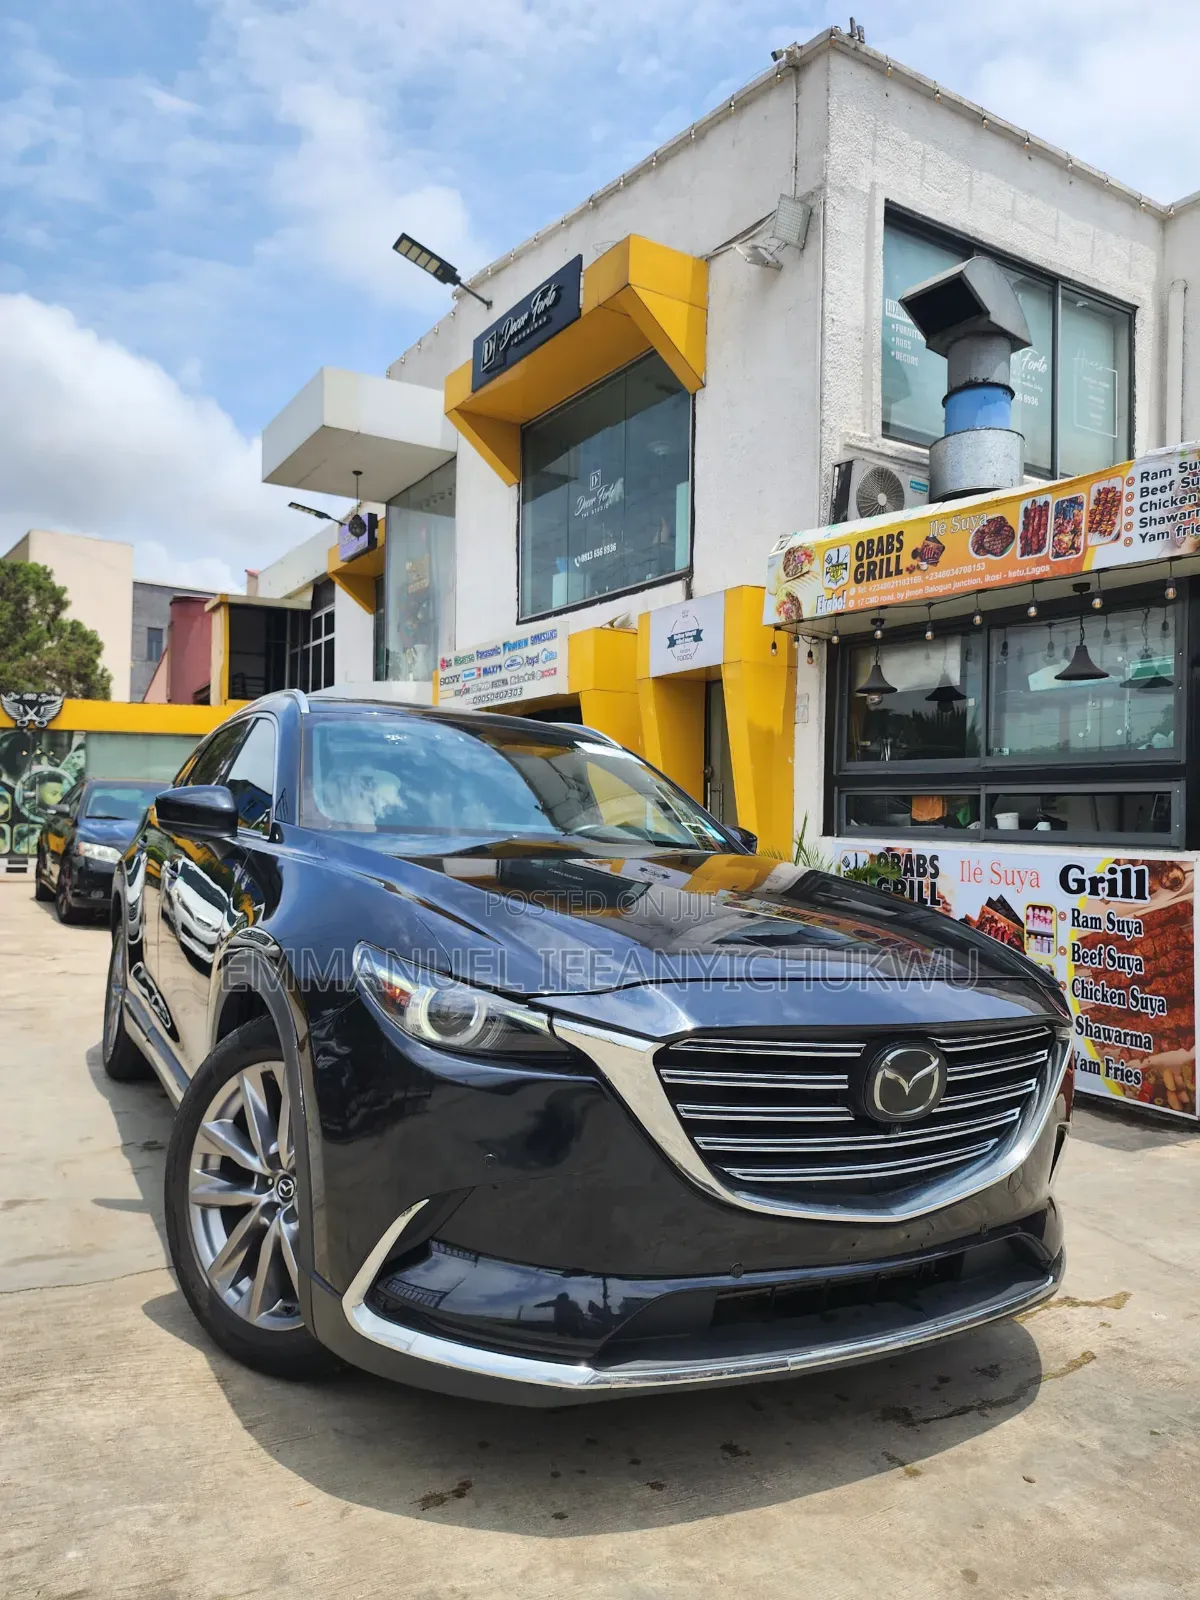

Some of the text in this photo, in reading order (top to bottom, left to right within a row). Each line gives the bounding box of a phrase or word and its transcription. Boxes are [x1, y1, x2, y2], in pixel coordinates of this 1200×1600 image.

[895, 336, 912, 350] RUGS
[895, 350, 919, 367] DECORS
[1139, 476, 1200, 498] Beef Su
[1140, 467, 1172, 483] Ram
[1139, 492, 1197, 513] Chicken
[949, 512, 988, 533] Suya
[1138, 530, 1170, 543] Yam
[581, 550, 593, 563] 0813
[593, 547, 603, 559] 656
[855, 530, 904, 562] OBABS
[853, 554, 903, 584] GRILL
[476, 645, 501, 660] Panasonic
[530, 628, 558, 646] SAMSUNG
[440, 674, 461, 686] SONY
[525, 652, 540, 668] Royal
[960, 858, 983, 883] Ilé
[990, 861, 1041, 894] Suya
[1058, 863, 1149, 901] Grill
[1071, 908, 1143, 939] Ram Suya
[1071, 942, 1144, 976] Beef Suya
[1071, 977, 1166, 1017] Chicken Suya
[1075, 1015, 1152, 1051] Shawarma
[1104, 1057, 1142, 1085] Fries
